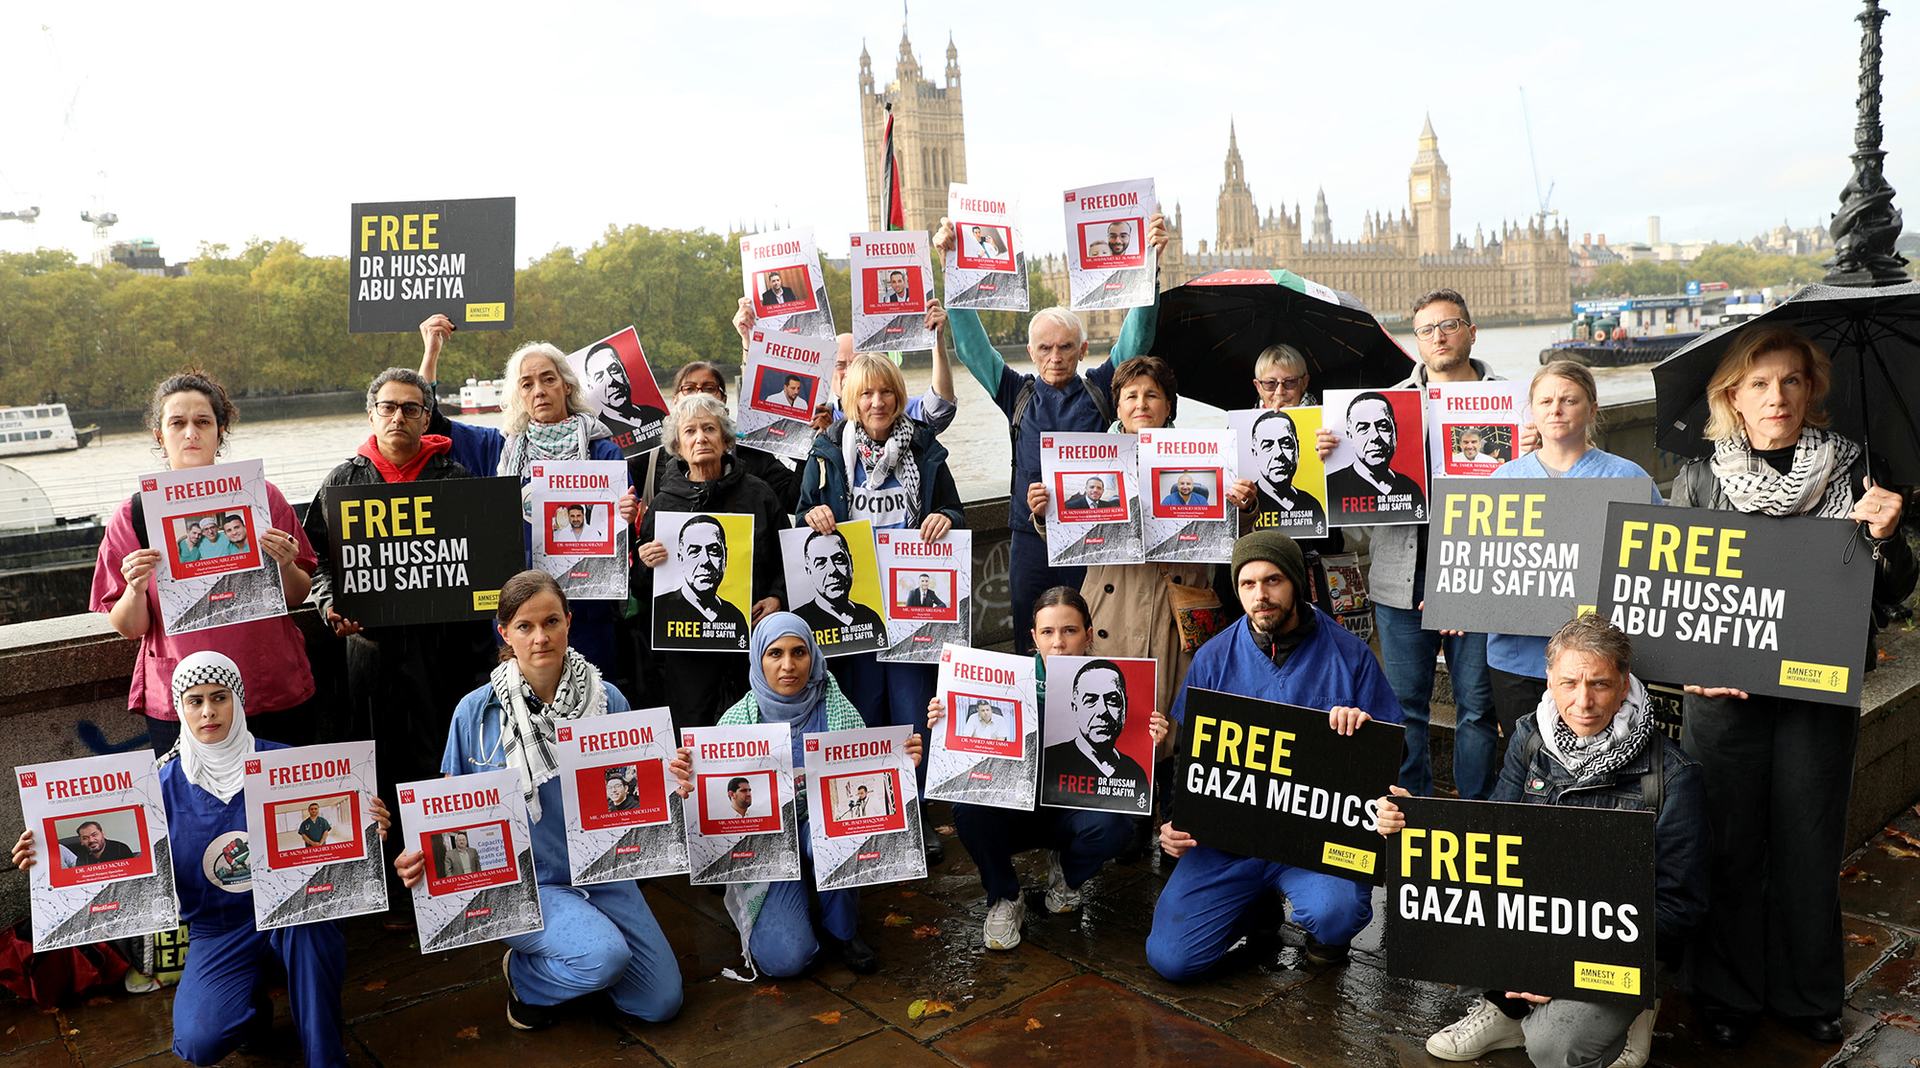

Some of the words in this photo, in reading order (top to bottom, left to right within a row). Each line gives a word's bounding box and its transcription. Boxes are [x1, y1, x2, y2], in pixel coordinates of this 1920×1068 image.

[961, 198, 1006, 214] FREEDOM
[1081, 192, 1138, 210] FREEDOM
[362, 213, 439, 251] FREE
[754, 241, 800, 259] FREEDOM
[866, 242, 915, 256] FREEDOM
[360, 256, 383, 277] DR
[391, 254, 465, 276] HUSSAM
[358, 279, 394, 301] ABU
[401, 277, 464, 300] SAFIYA
[766, 342, 820, 364] FREEDOM
[1447, 396, 1513, 410] FREEDOM
[610, 432, 634, 448] REE
[1157, 442, 1218, 454] FREEDOM
[1058, 445, 1118, 459] FREEDOM
[165, 476, 242, 501] FREEDOM
[549, 475, 609, 489] FREEDOM
[1342, 496, 1375, 512] FREE
[1377, 495, 1387, 503] DR
[1387, 494, 1412, 502] HUSSAM
[1378, 503, 1390, 511] ABU
[1391, 502, 1412, 511] SAFIYA
[340, 496, 435, 540] FREE
[1256, 511, 1279, 527] REE
[1290, 510, 1313, 518] HUSSAM
[1293, 518, 1314, 526] SAFIYA
[1443, 494, 1546, 537] FREE
[342, 544, 372, 568] DR
[380, 538, 468, 566] HUSSAM
[895, 542, 952, 556] FREEDOM
[1439, 541, 1471, 566] DR
[1479, 542, 1579, 570] HUSSAM
[1619, 520, 1746, 579] FREE
[344, 569, 386, 594] ABU
[395, 563, 469, 590] SAFIYA
[1436, 569, 1484, 594] ABU
[1492, 569, 1575, 598] SAFIYA
[1613, 574, 1651, 605] DR
[1661, 578, 1785, 619] HUSSAM
[668, 621, 700, 638] FREE
[712, 622, 736, 630] HUSSAM
[716, 630, 736, 638] SAFIYA
[841, 626, 849, 634] DR
[850, 623, 873, 632] HUSSAM
[1610, 605, 1667, 638] ABU
[1676, 612, 1778, 651] SAFIYA
[812, 628, 840, 645] REE
[842, 634, 853, 642] ABU
[854, 631, 874, 640] SAFIYA
[954, 663, 1015, 685] FREEDOM
[1786, 675, 1822, 684] INTERNATIONAL
[1787, 666, 1823, 677] AMNESTY
[580, 726, 654, 752] FREEDOM
[1192, 715, 1296, 776] FREE
[701, 740, 769, 759] FREEDOM
[825, 740, 892, 761] FREEDOM
[269, 758, 351, 785] FREEDOM
[45, 771, 133, 800] FREEDOM
[1059, 774, 1095, 795] FREE
[1097, 777, 1107, 786] DR
[1109, 778, 1136, 788] HUSSAM
[1097, 787, 1111, 795] ABU
[1112, 788, 1134, 797] SAFIYA
[1187, 762, 1257, 805] GAZA
[1266, 778, 1378, 831] MEDICS
[422, 788, 500, 815] FREEDOM
[1328, 848, 1356, 859] AMNESTY
[1401, 828, 1523, 887] FREE
[1400, 883, 1486, 926] GAZA
[1497, 892, 1639, 942] MEDICS
[1581, 968, 1615, 980] AMNESTY
[1581, 977, 1614, 986] INTERNATIONAL
